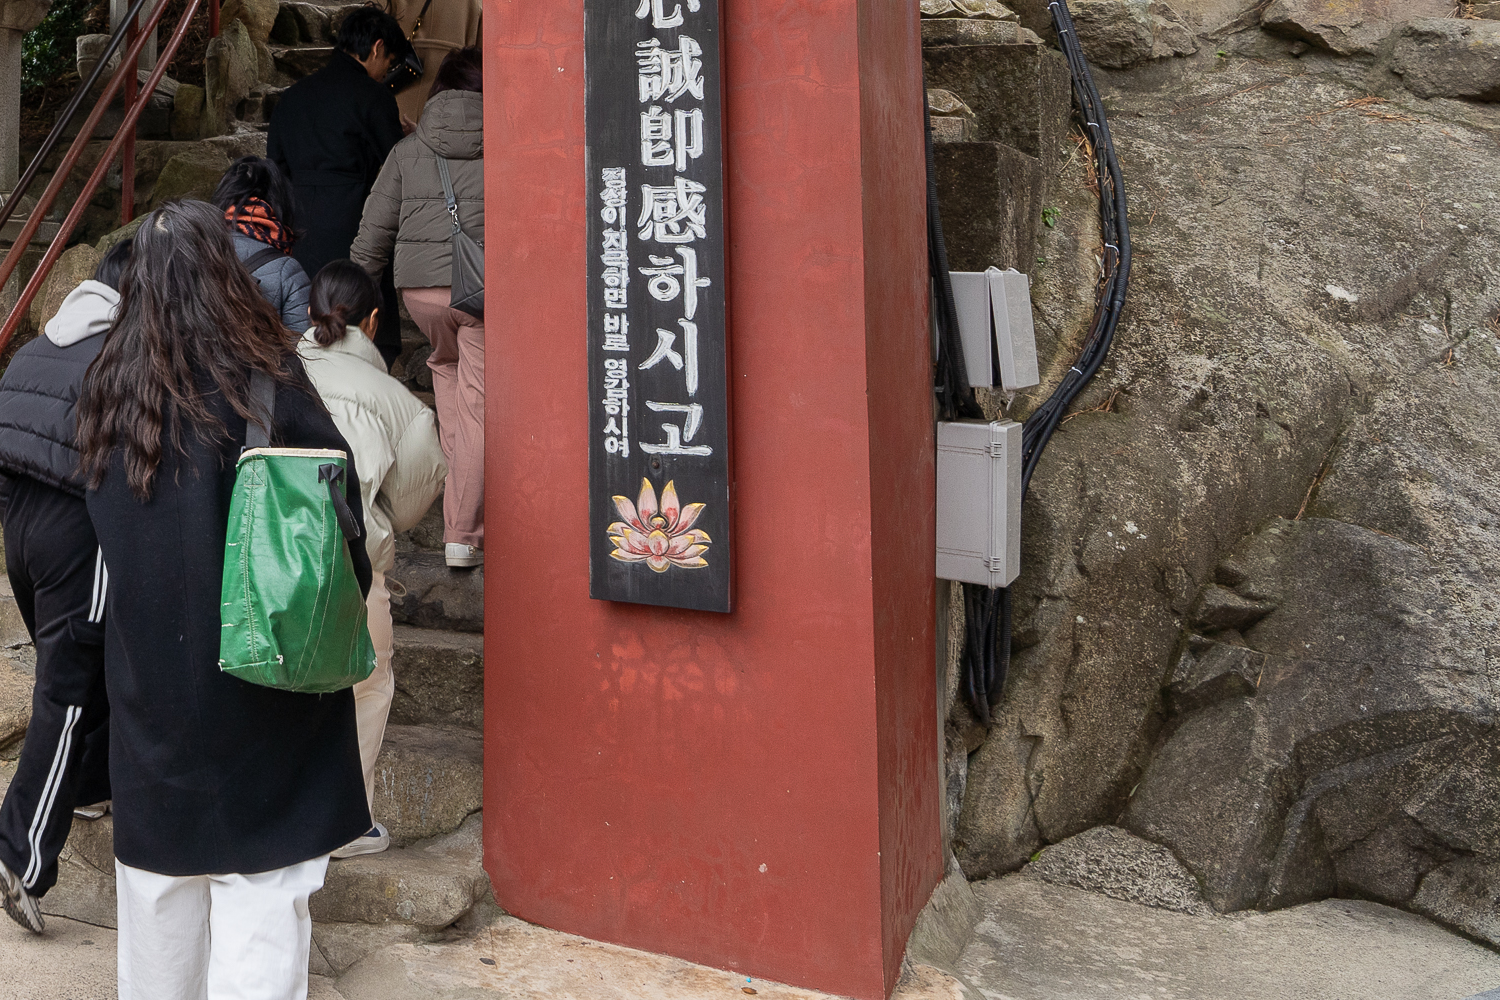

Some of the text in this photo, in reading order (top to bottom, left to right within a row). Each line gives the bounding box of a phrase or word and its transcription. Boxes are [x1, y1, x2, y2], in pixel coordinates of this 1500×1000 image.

[600, 166, 628, 228] 정성이
[600, 229, 631, 308] 지극하면
[601, 312, 631, 352] 바로
